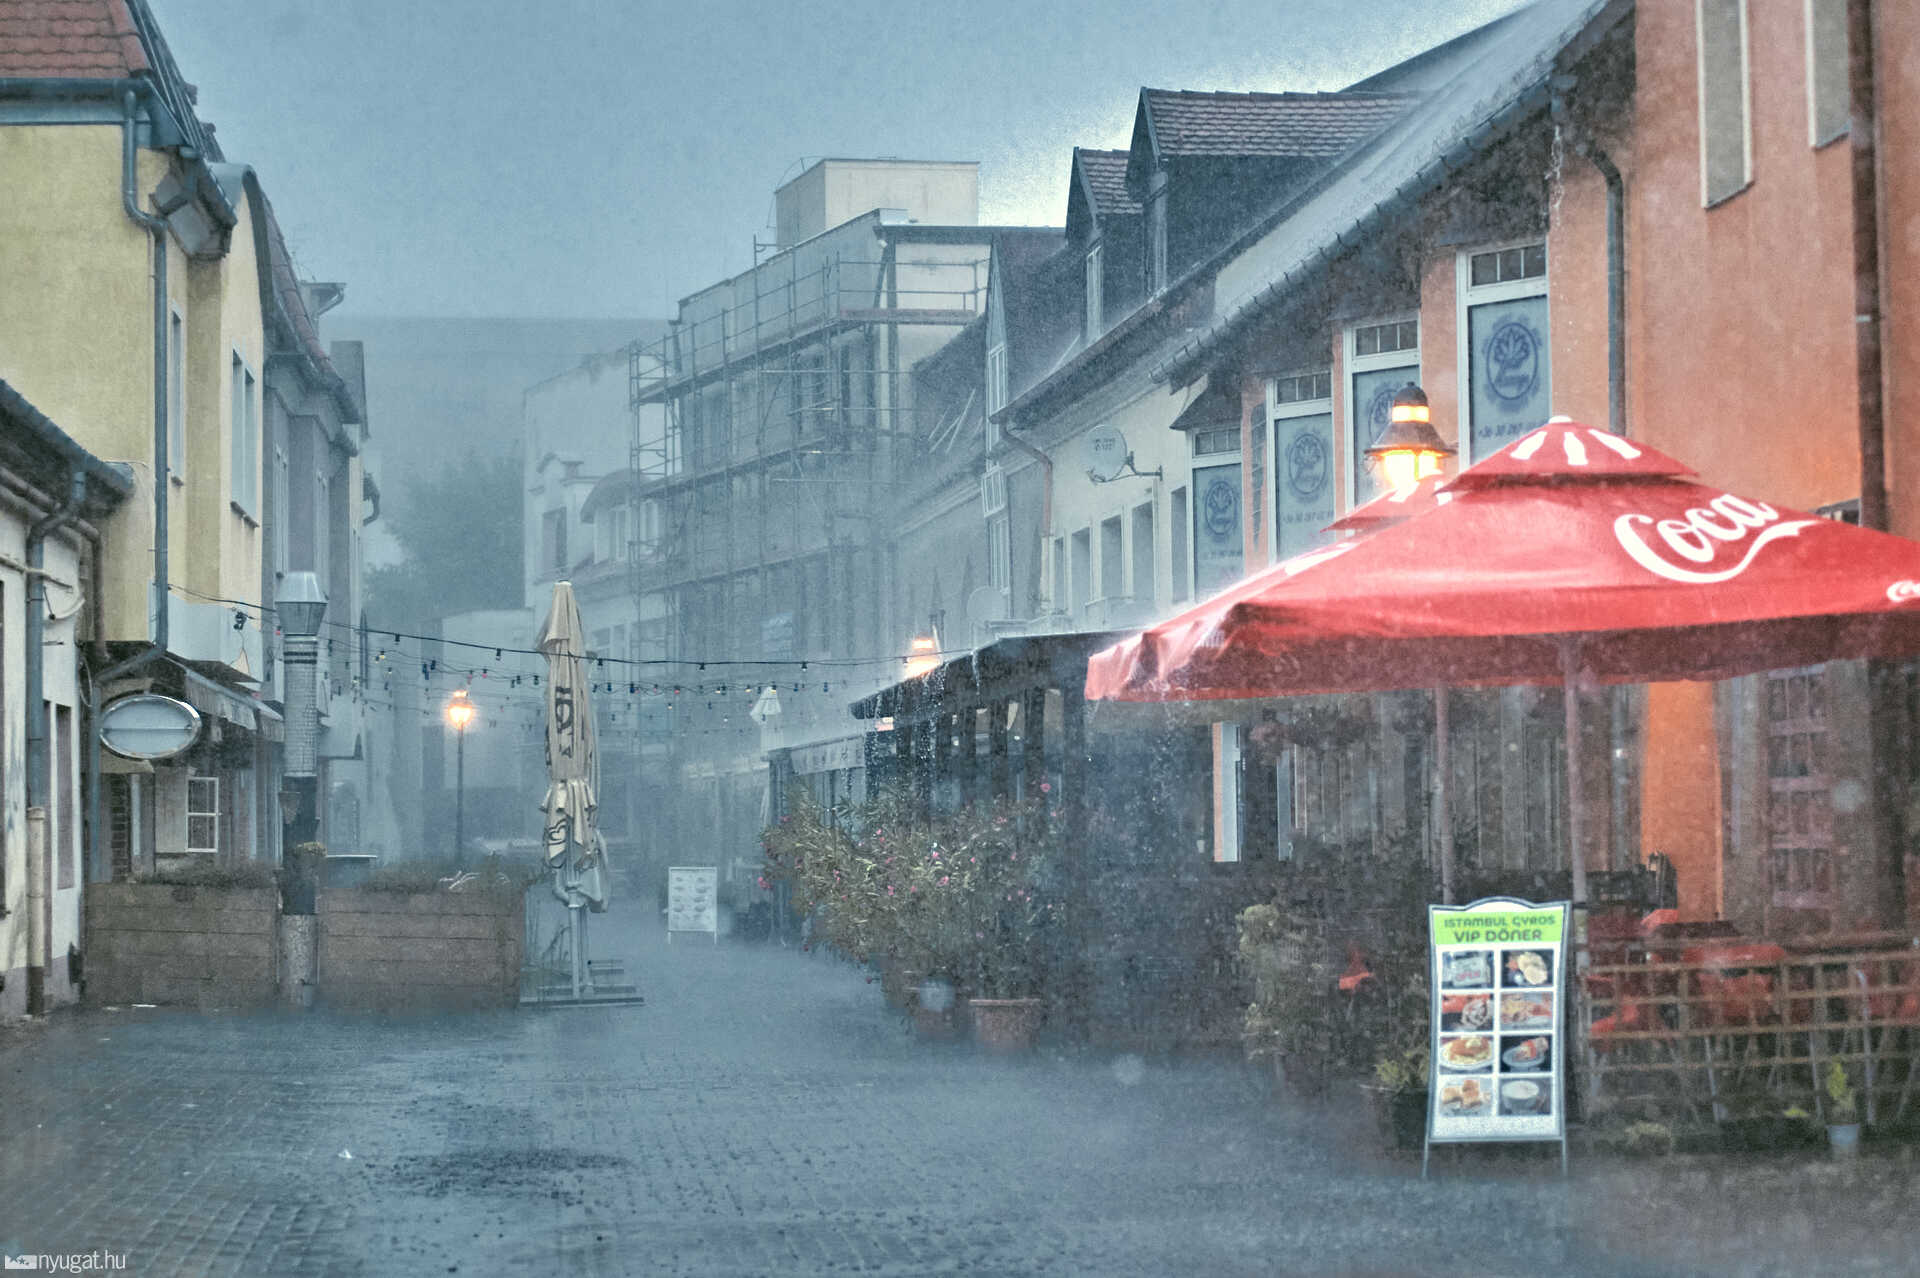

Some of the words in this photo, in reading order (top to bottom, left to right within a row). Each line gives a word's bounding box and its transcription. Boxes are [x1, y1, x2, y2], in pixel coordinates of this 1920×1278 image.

[1614, 493, 1817, 584] Coca
[1444, 917, 1508, 928] ISTAMBUL
[1512, 915, 1555, 927] GYROS
[1454, 931, 1480, 942] VIP
[1485, 929, 1542, 941] DÖNER
